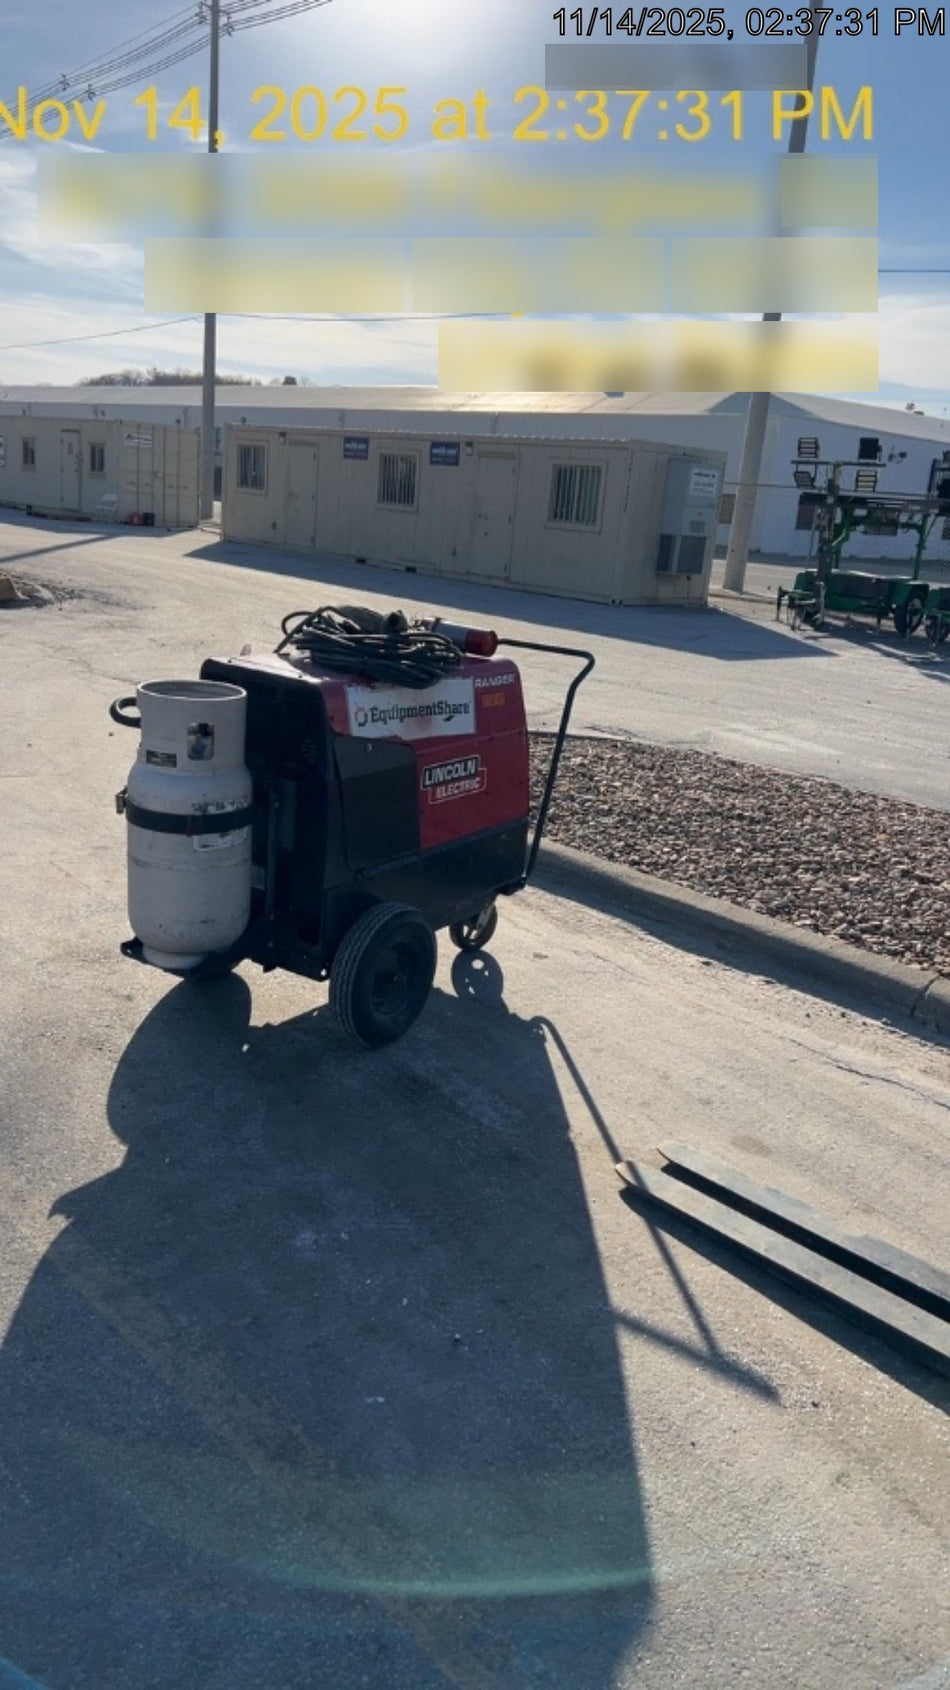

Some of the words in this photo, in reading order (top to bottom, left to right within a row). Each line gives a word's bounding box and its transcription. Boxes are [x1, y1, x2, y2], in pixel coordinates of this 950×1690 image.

[474, 674, 516, 689] RANGER
[369, 700, 471, 726] EquipmentShare
[424, 758, 477, 786] LINCOLN
[435, 777, 482, 799] ELECTRIC
